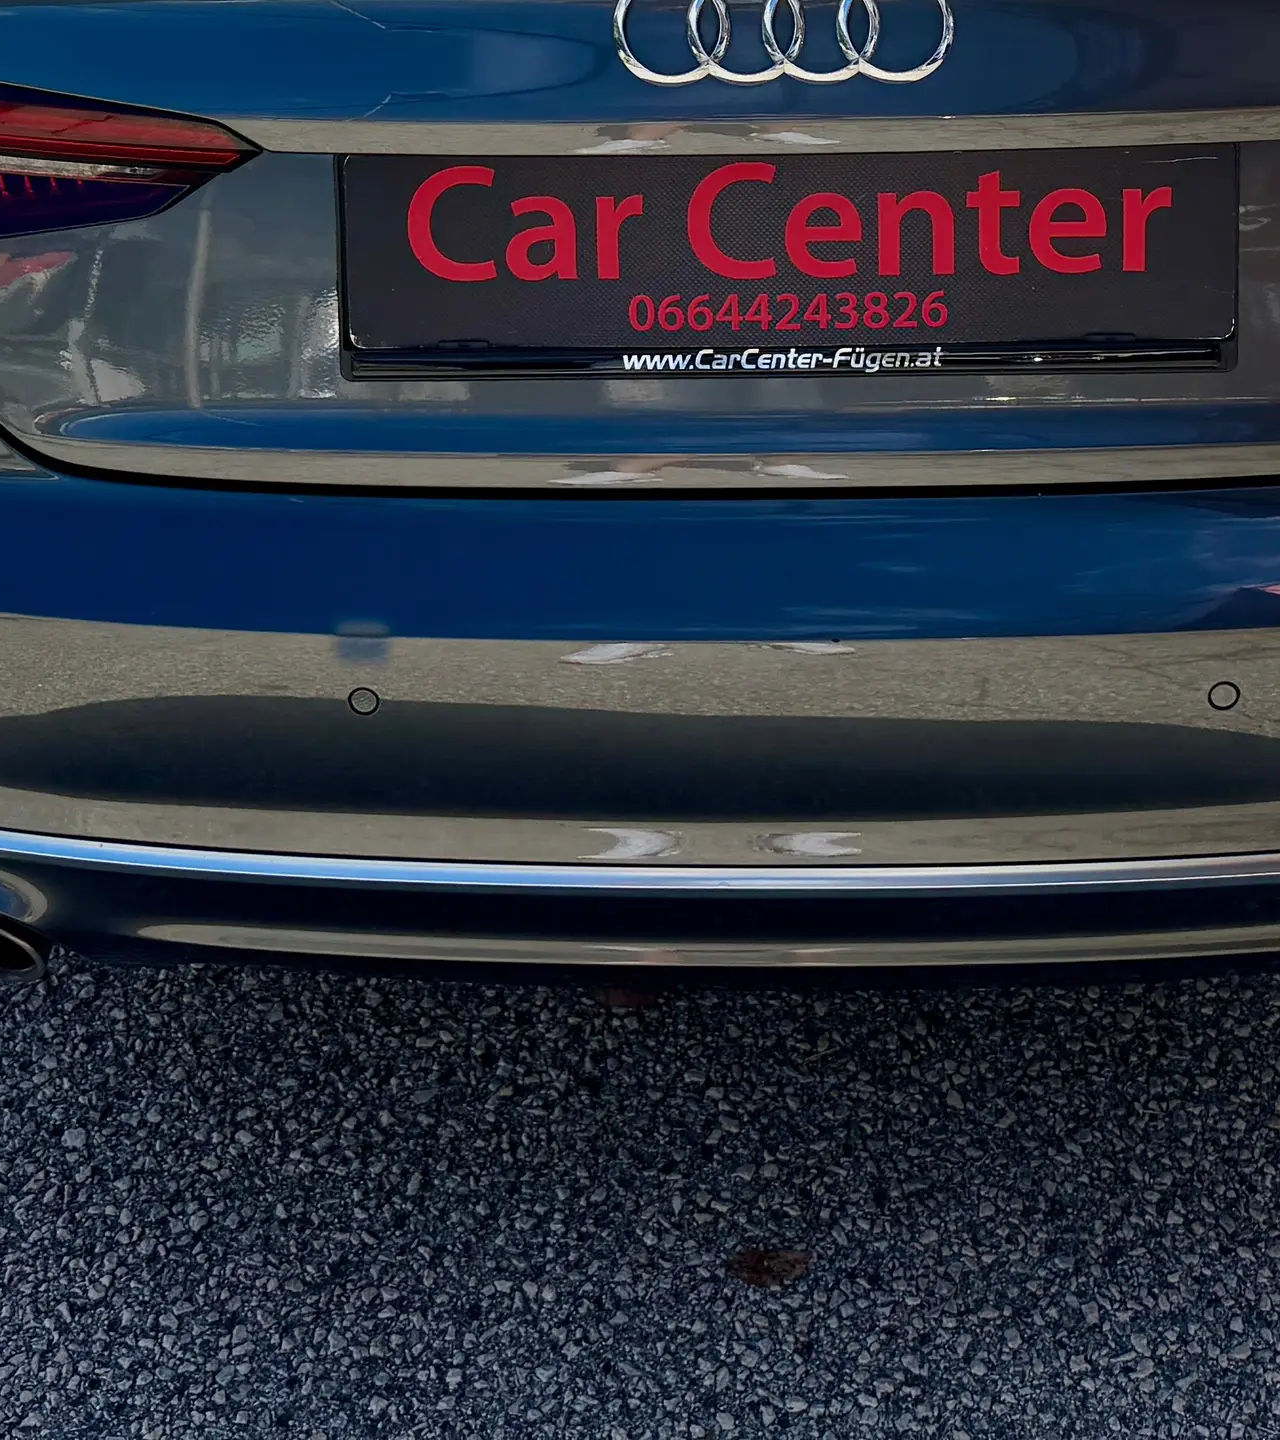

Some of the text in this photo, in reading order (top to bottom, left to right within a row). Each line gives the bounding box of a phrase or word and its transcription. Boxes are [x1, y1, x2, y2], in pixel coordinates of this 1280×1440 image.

[407, 161, 1173, 282] Car Center
[628, 290, 949, 332] 06644243826
[622, 346, 944, 373] www.CarCenter-Fügen.at
